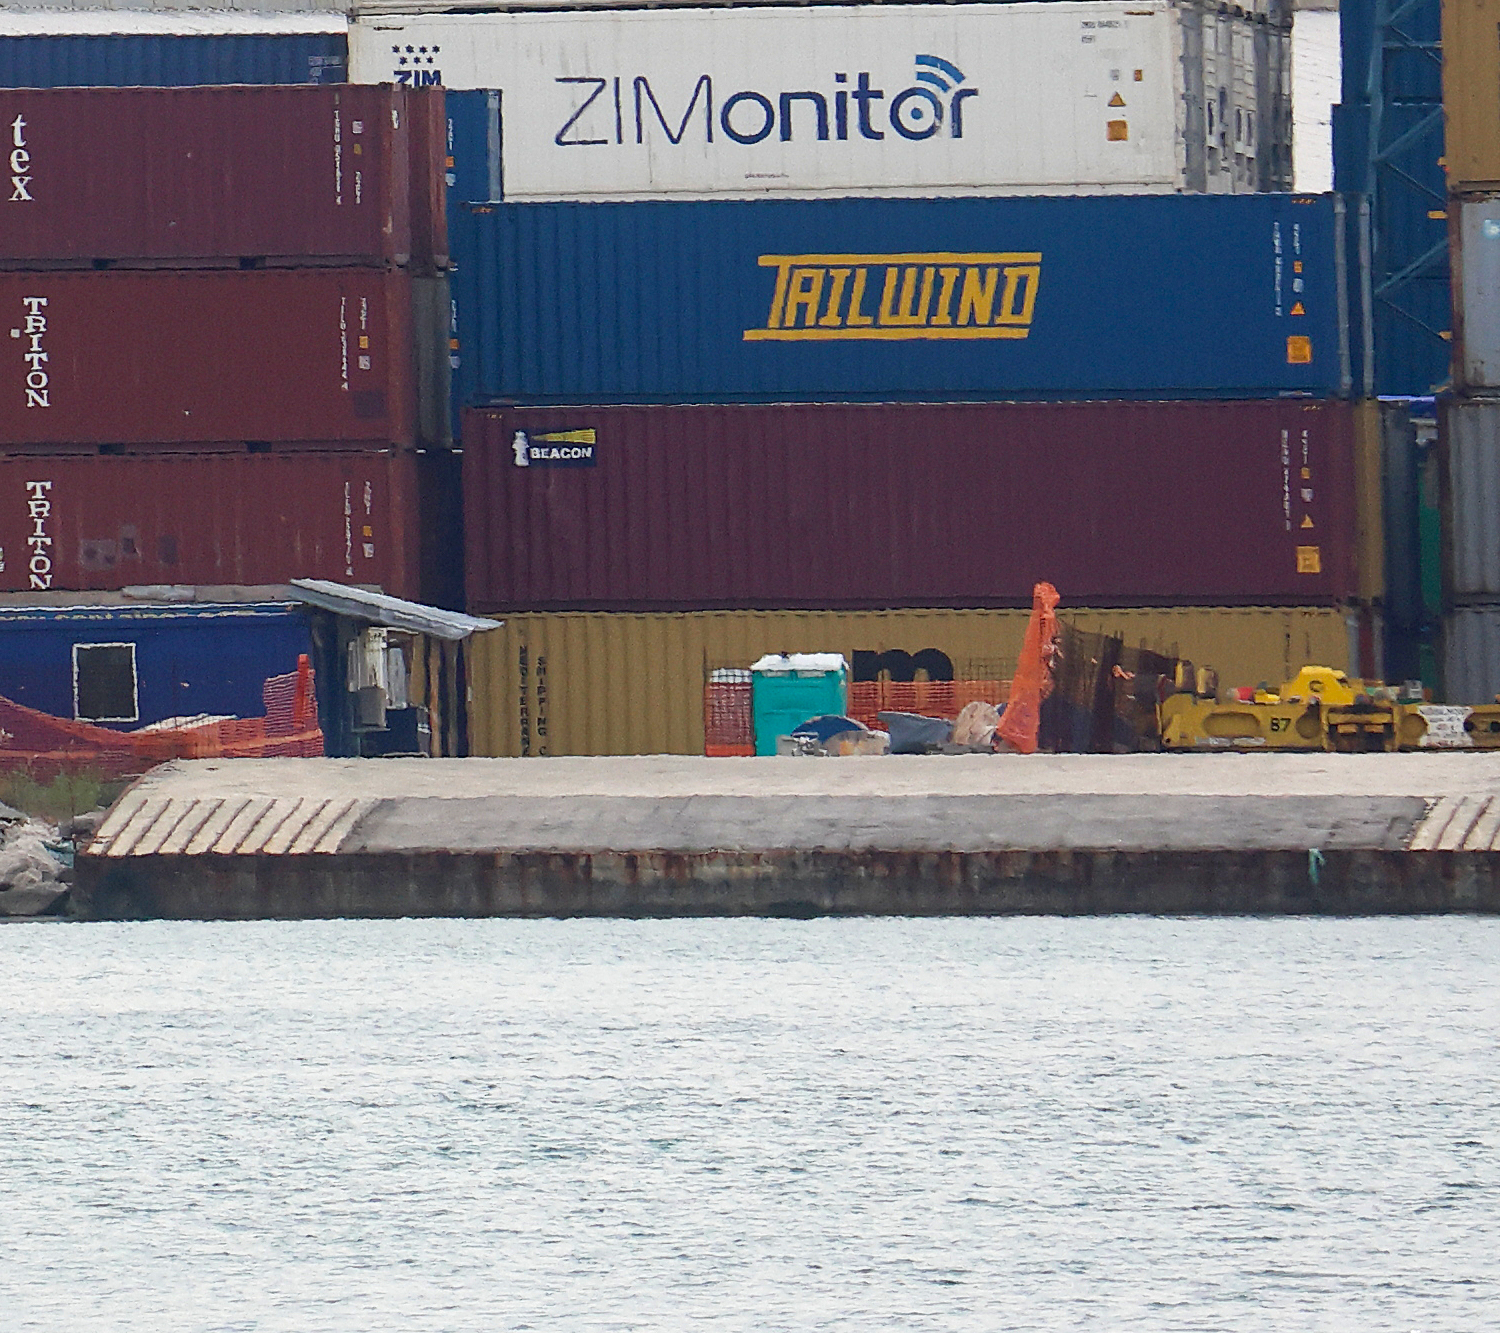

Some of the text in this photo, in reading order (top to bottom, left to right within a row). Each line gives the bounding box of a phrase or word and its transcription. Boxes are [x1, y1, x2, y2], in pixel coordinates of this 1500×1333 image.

[393, 69, 442, 87] ZIM
[554, 71, 980, 147] ZIMonitor
[7, 113, 34, 203] tex
[745, 252, 1043, 341] TAILWIND
[22, 295, 51, 409] TRITON
[530, 445, 594, 463] BEACON
[25, 479, 54, 591] TRITON
